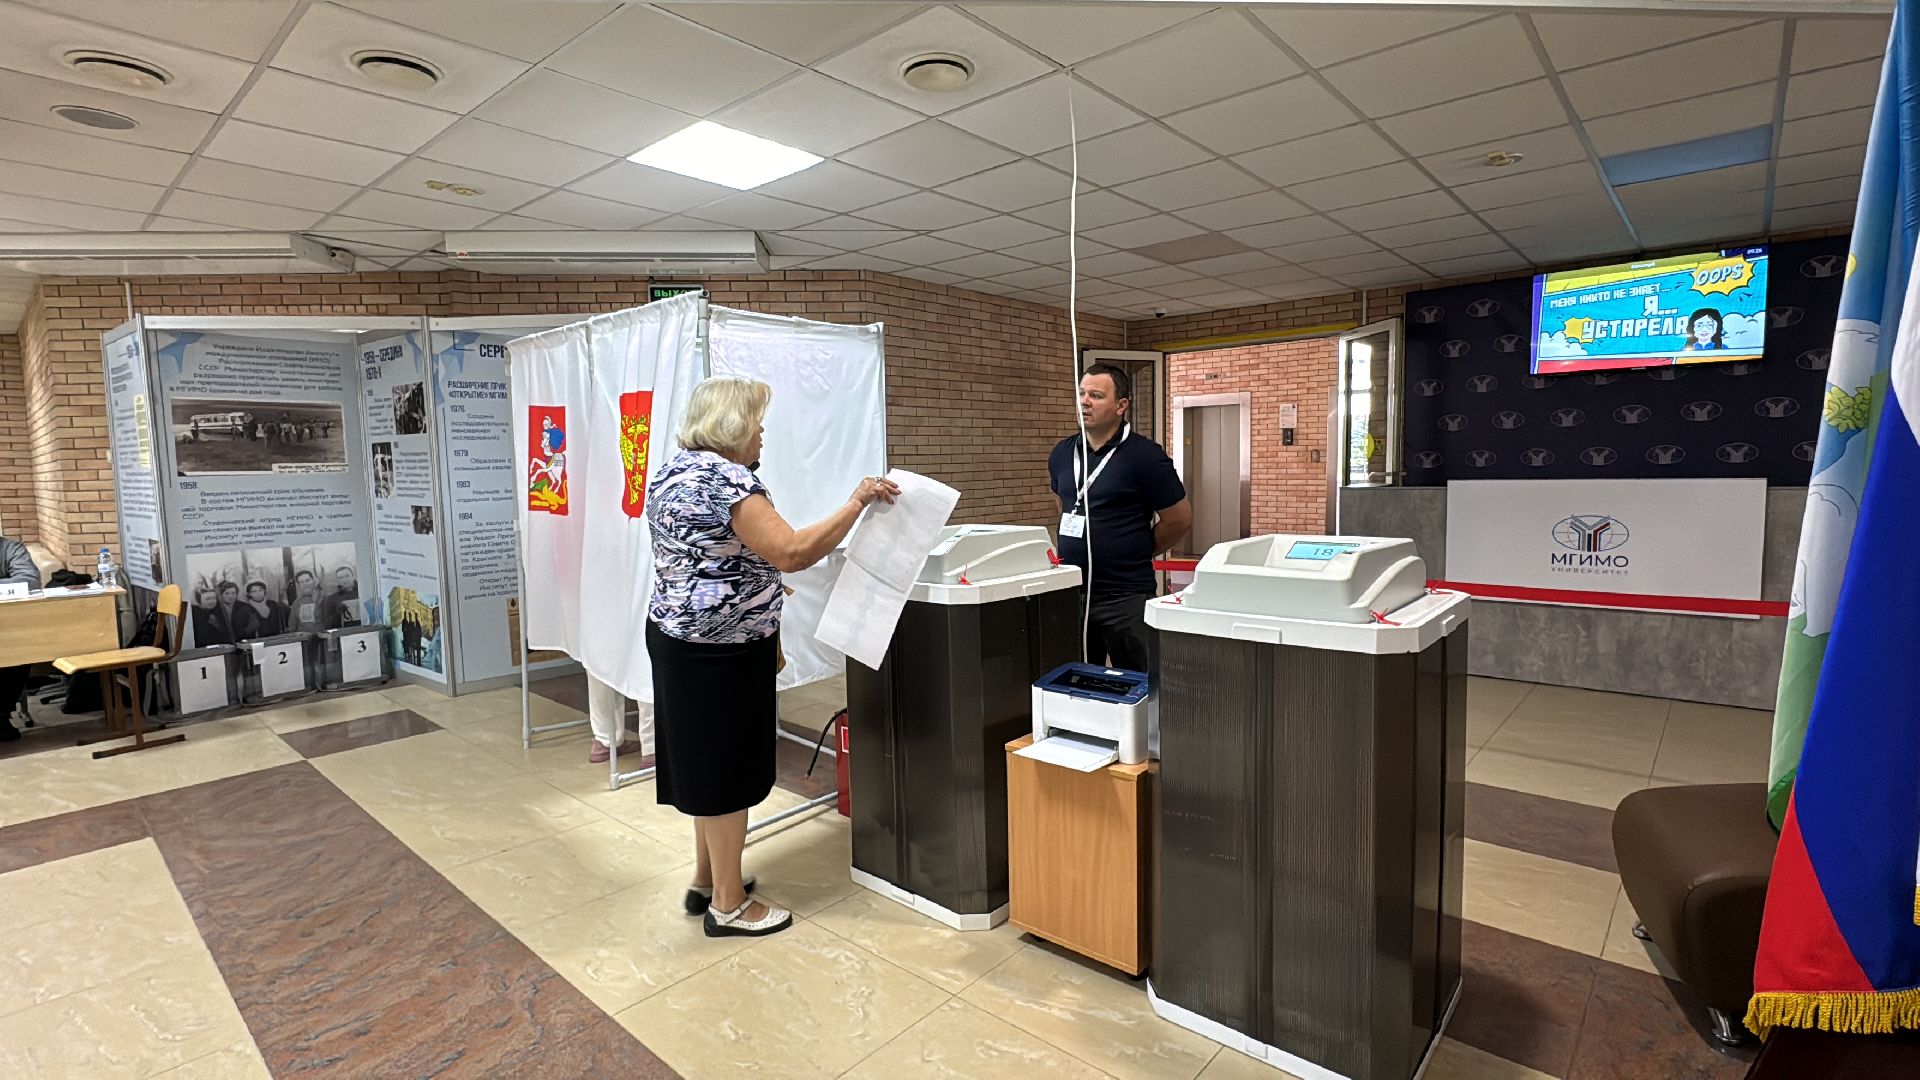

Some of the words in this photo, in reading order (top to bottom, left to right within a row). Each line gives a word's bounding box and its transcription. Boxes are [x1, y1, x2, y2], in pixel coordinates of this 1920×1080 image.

[1696, 264, 1744, 286] OOPS
[1550, 296, 1576, 309] МЕНЯ
[1580, 291, 1610, 304] НИКТО
[1614, 288, 1626, 299] НЕ
[1642, 296, 1678, 317] Я...
[1582, 316, 1688, 339] УСТАРЕЛА
[448, 381, 489, 390] РАСШИРЕНИЕ
[1314, 548, 1334, 556] 18
[1552, 553, 1628, 568] МГИМО
[1552, 567, 1628, 576] УНИВЕРСИТЕТ
[357, 640, 366, 652] 3
[278, 652, 288, 664] 2
[201, 666, 207, 679] 1
